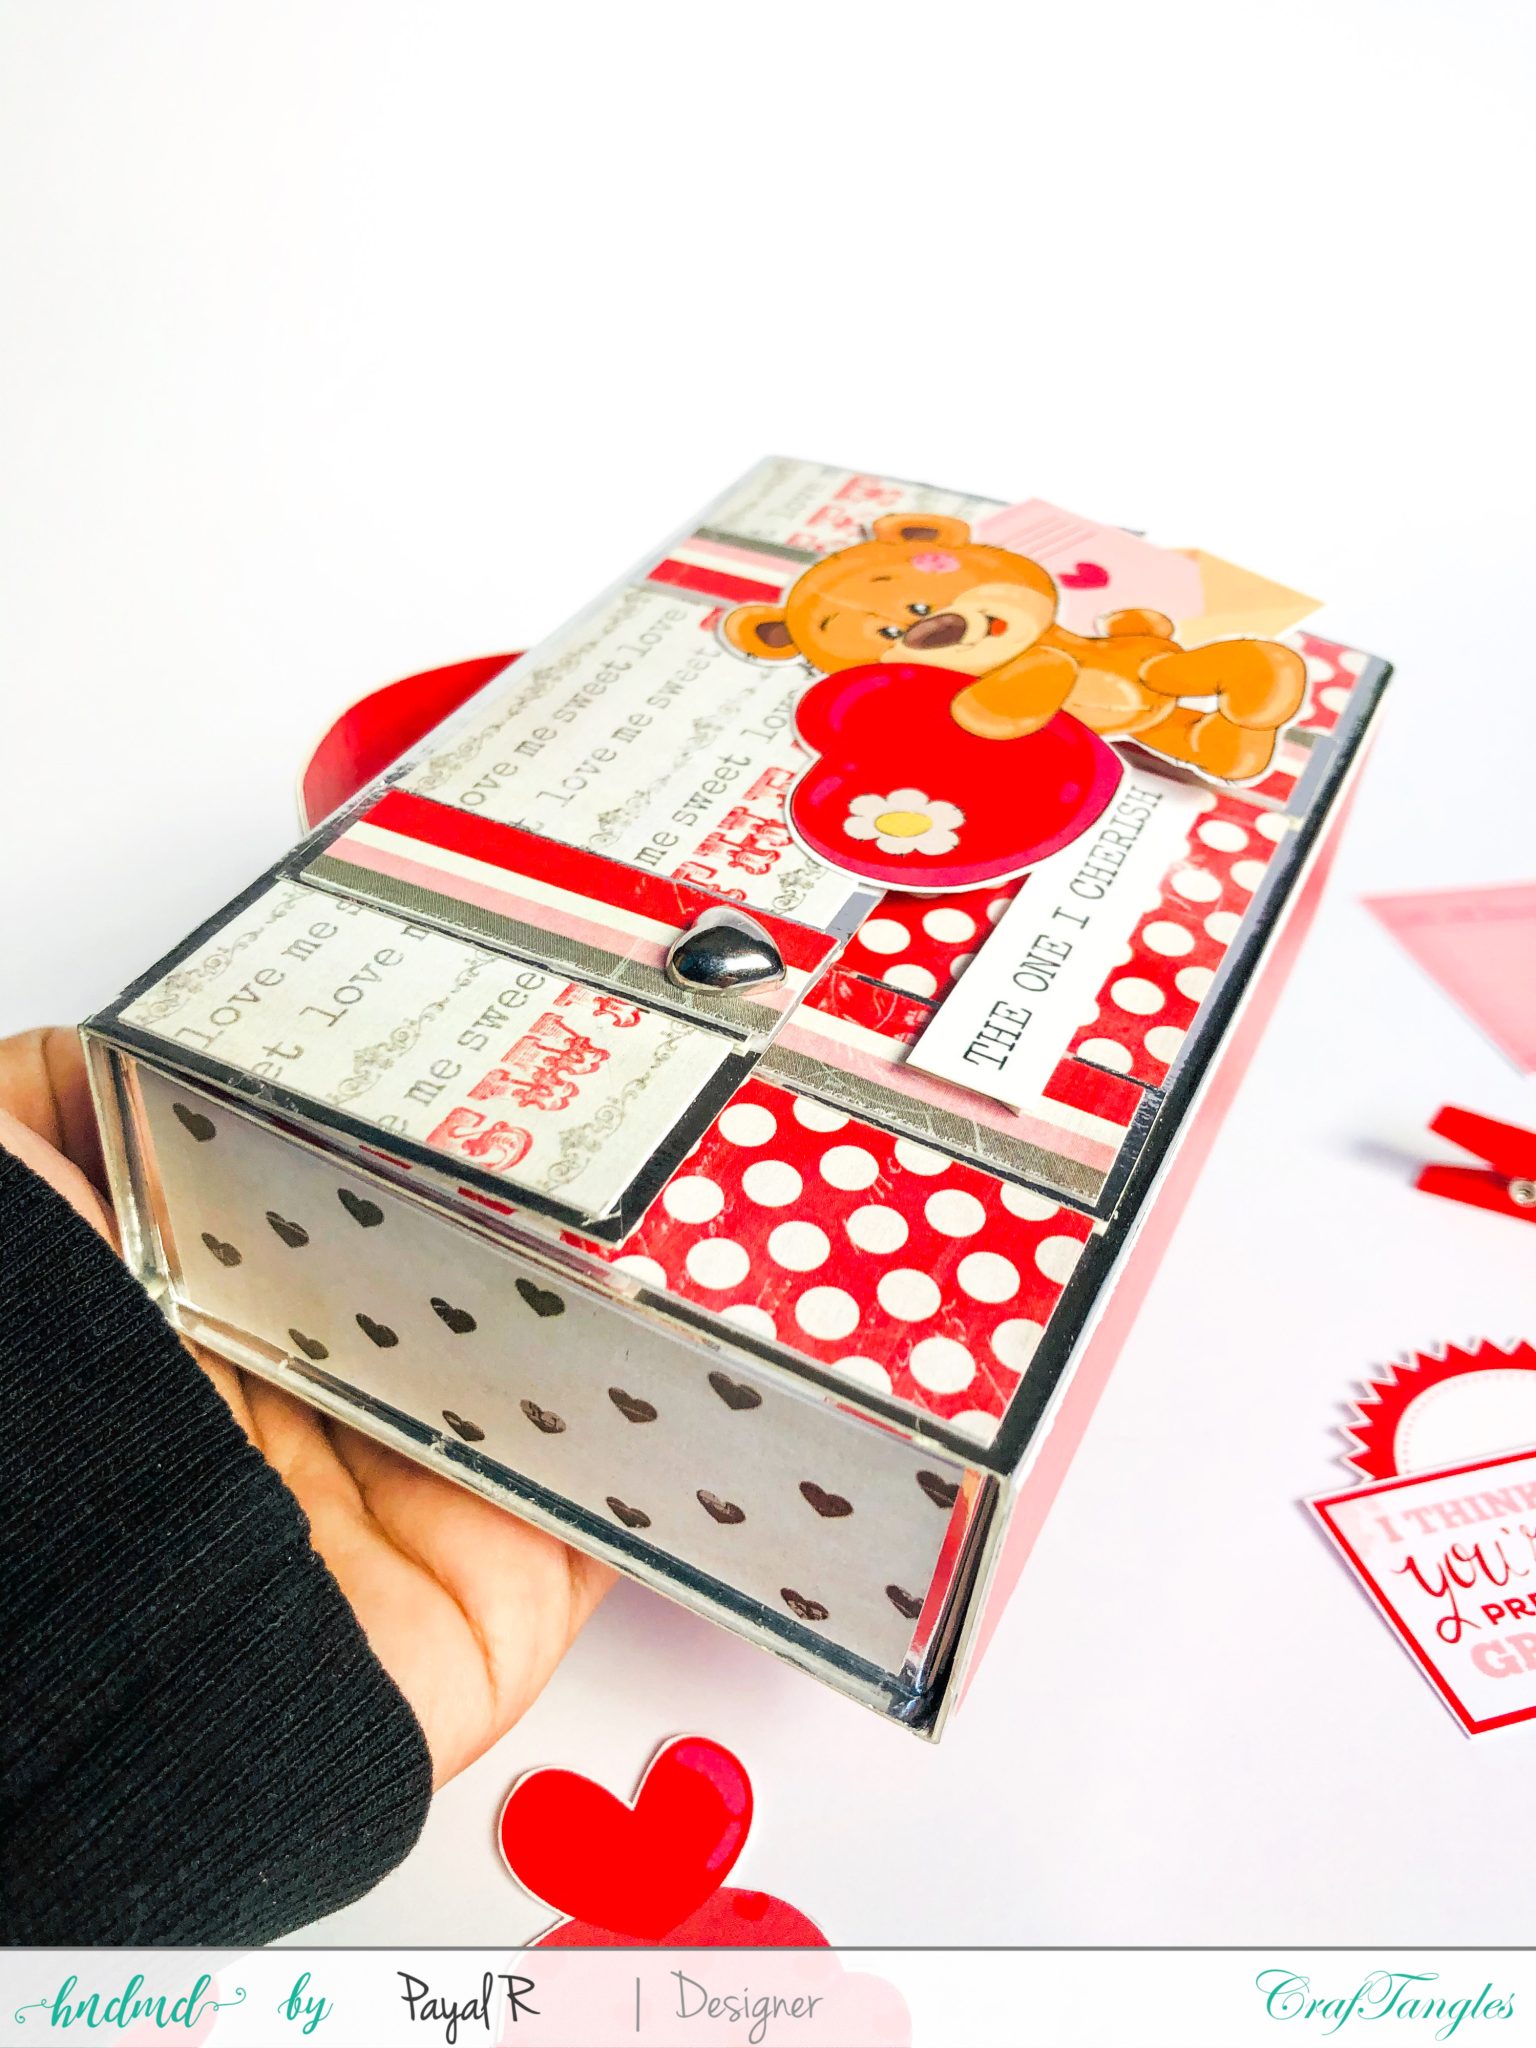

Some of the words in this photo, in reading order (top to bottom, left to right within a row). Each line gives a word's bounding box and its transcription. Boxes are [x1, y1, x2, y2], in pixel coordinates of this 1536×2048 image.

[514, 725, 557, 758] me
[553, 658, 631, 724] sweet
[627, 607, 688, 662] love
[535, 746, 618, 808] love
[611, 711, 653, 745] me
[647, 645, 722, 710] sweet
[634, 832, 679, 867] me
[672, 753, 752, 828] sweet
[1068, 784, 1163, 900] CHERISH
[1012, 933, 1073, 993] ONE
[1051, 906, 1090, 930] I
[174, 967, 287, 1050] love
[281, 921, 340, 962] me
[299, 948, 405, 1028] love
[404, 1058, 463, 1108] me
[962, 999, 1033, 1071] THE
